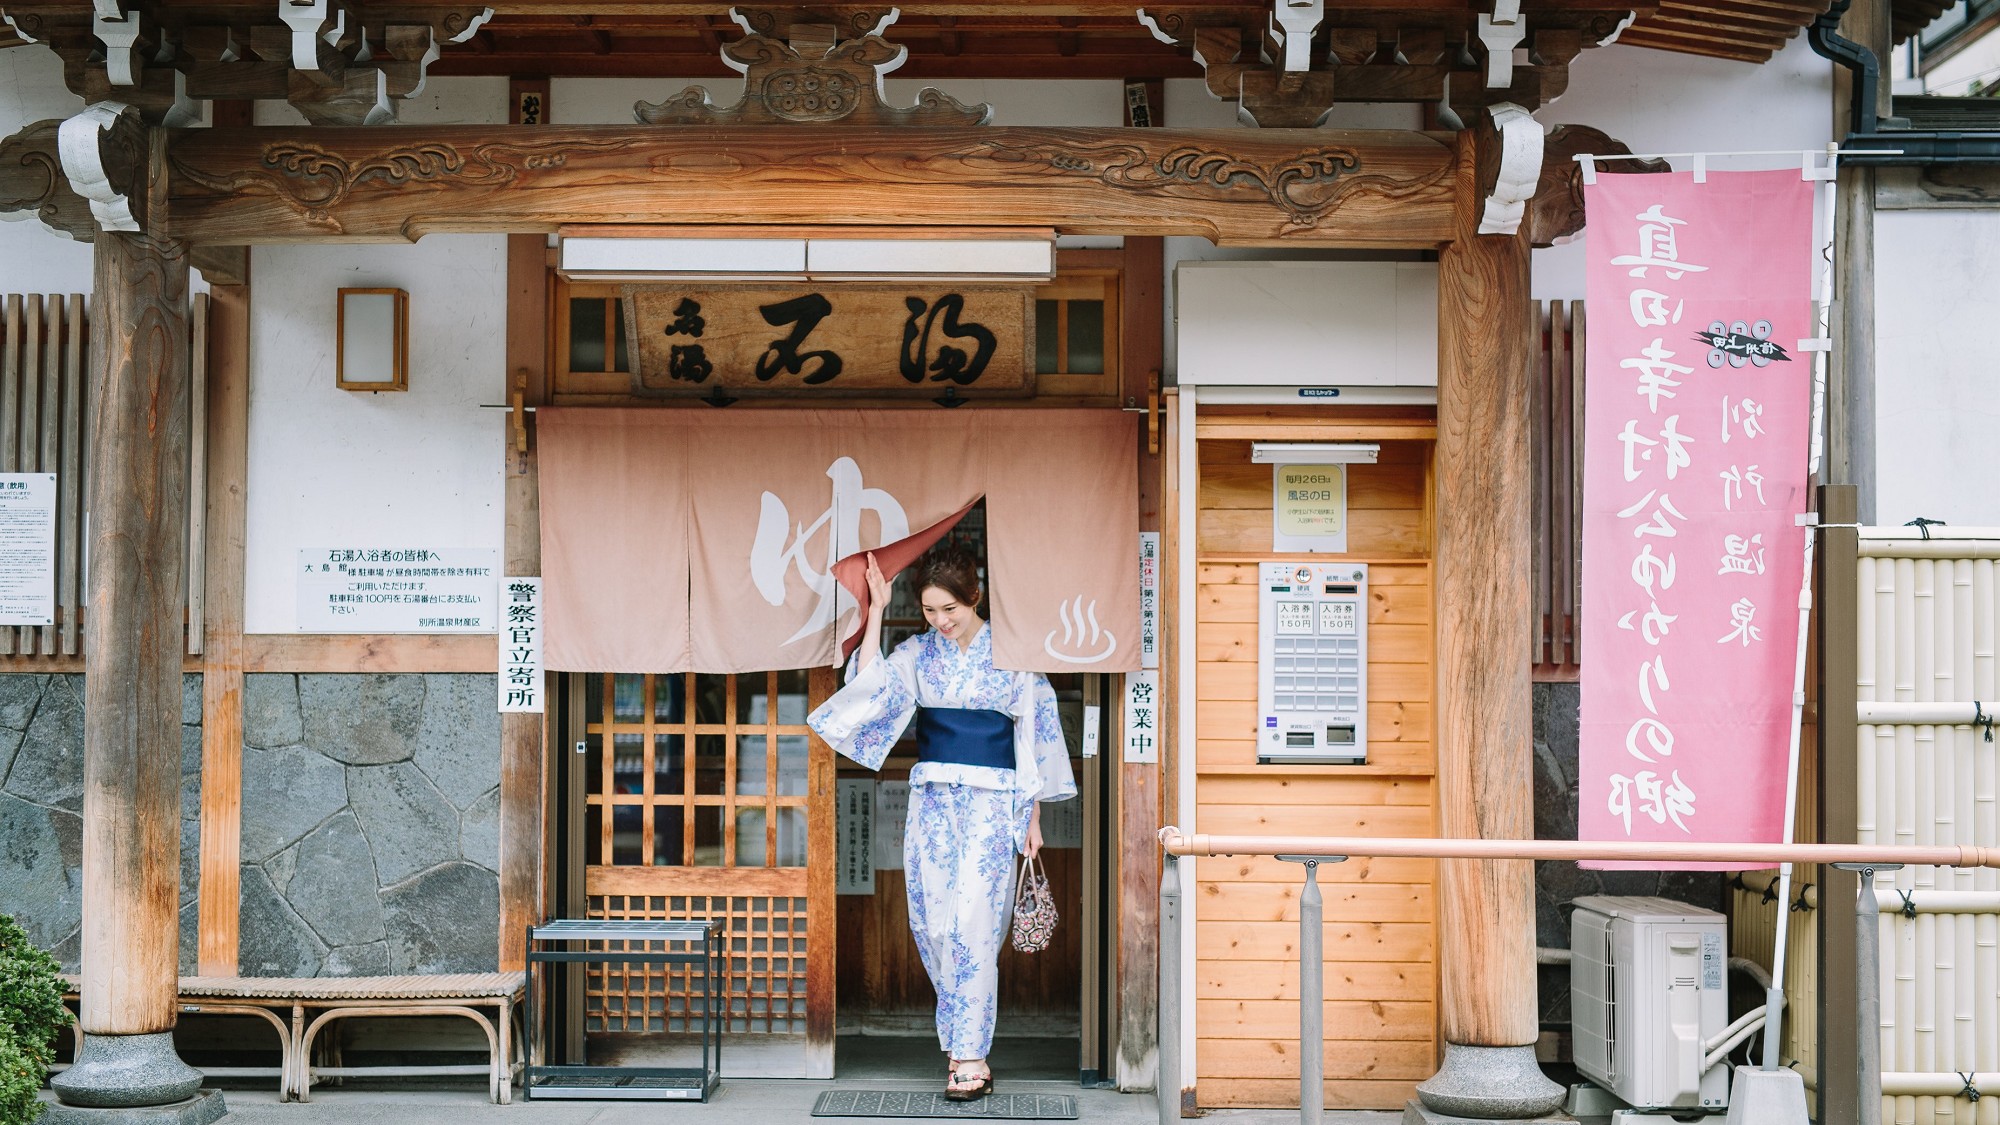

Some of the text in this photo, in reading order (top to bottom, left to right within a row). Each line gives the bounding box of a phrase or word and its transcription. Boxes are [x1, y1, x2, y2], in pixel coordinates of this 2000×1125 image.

[1288, 490, 1331, 500] 風呂の日
[329, 550, 441, 562] 石湯入浴者の皆様へ
[1281, 604, 1310, 612] 入浴券
[1323, 604, 1352, 613] 入浴券
[419, 618, 480, 627] 別所温泉財産区
[1323, 620, 1352, 628] 150円
[506, 583, 536, 706] 警察官立寄所
[1132, 682, 1152, 754] 営業中
